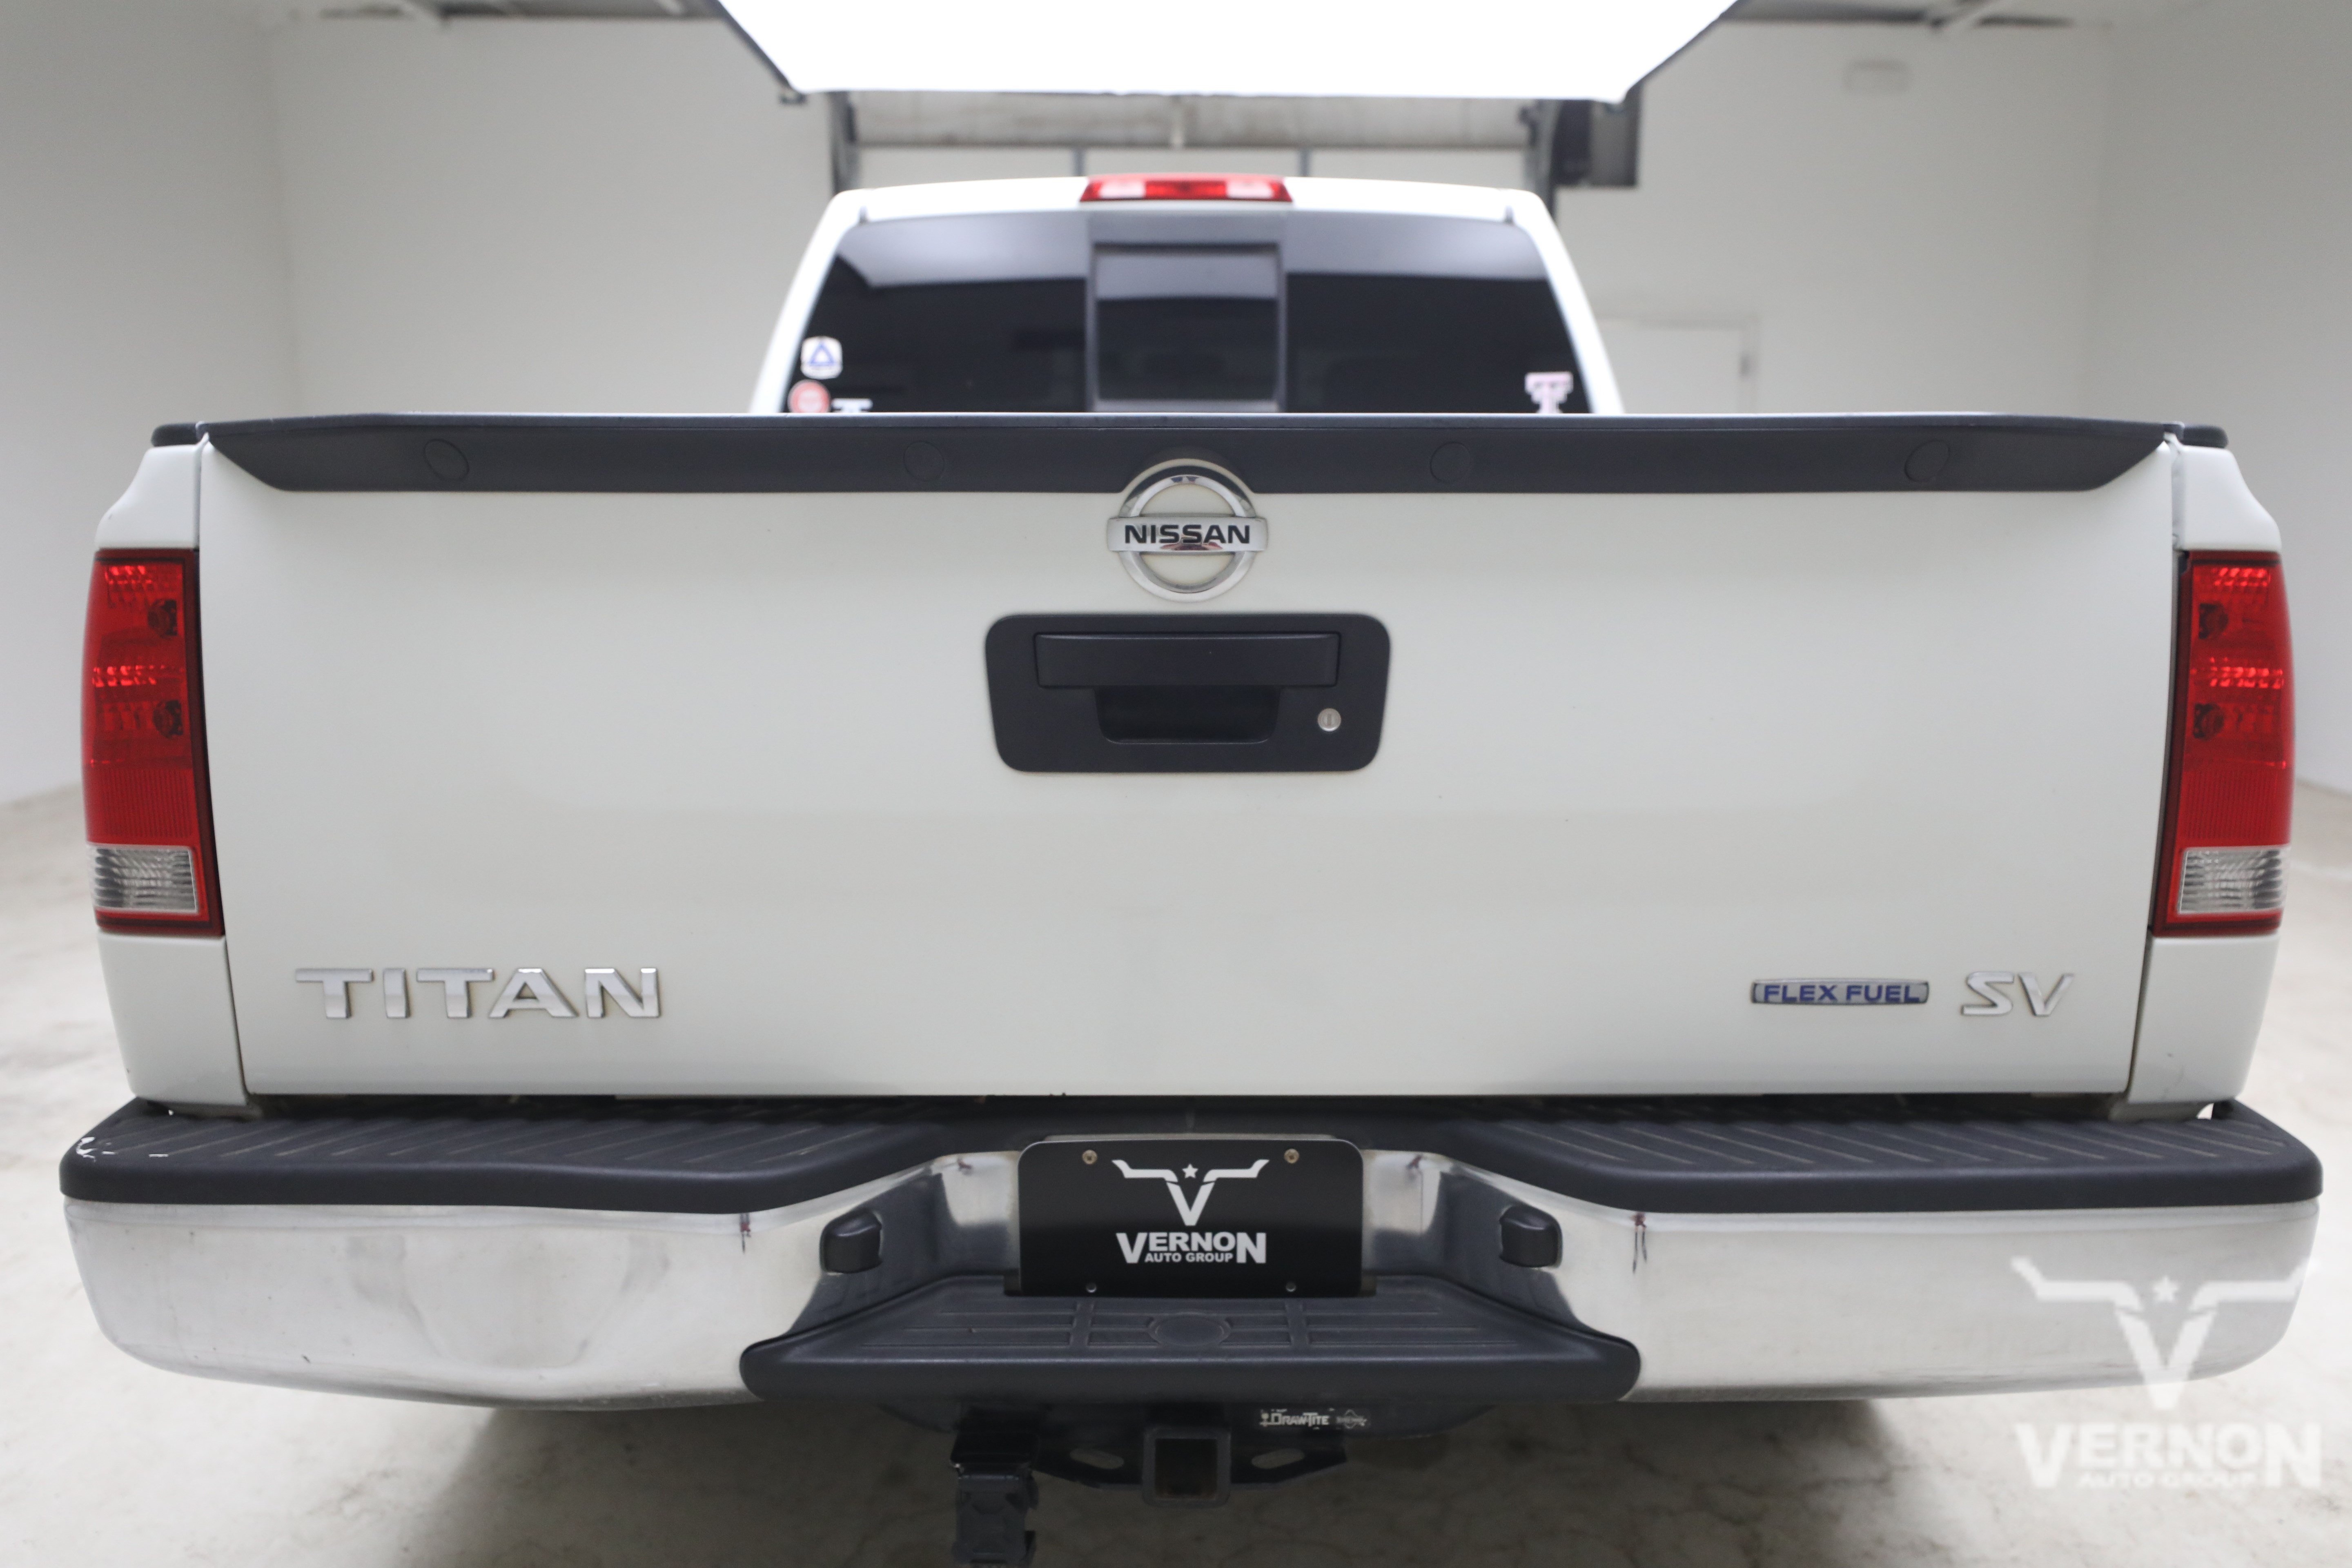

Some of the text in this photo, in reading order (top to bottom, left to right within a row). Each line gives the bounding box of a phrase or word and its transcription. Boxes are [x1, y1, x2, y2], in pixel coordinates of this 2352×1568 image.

[1125, 524, 1250, 544] NISSAN
[295, 967, 662, 1018] TITAN
[1764, 984, 1921, 1003] FLEX FUEL
[1961, 971, 2075, 1016] SV
[1115, 1231, 1267, 1264] VERNON
[1144, 1252, 1234, 1263] AUTO GROUP
